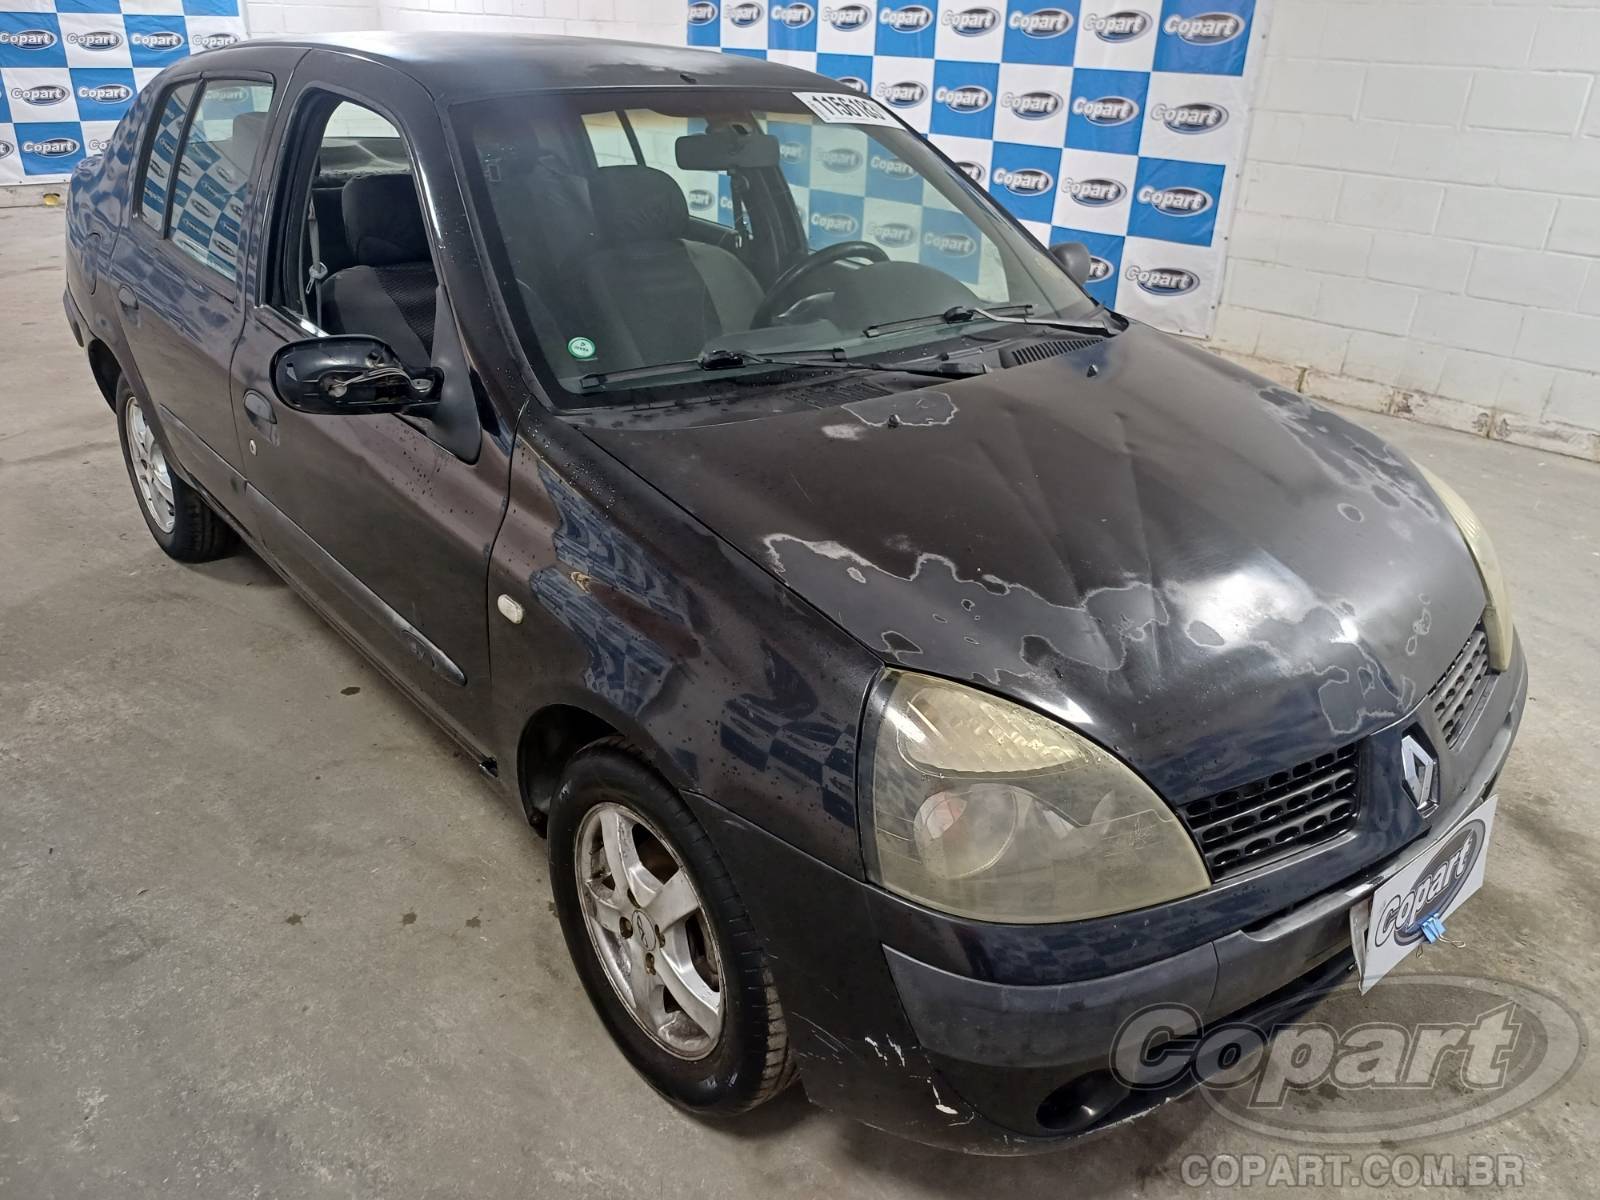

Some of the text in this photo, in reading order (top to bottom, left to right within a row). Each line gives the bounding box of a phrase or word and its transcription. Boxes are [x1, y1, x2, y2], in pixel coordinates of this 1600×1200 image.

[688, 5, 713, 21] part
[771, 5, 809, 24] Copart
[822, 7, 867, 26] Copart
[879, 8, 927, 28] Copart
[941, 9, 993, 31] Copart
[1009, 10, 1064, 32] Copart
[1084, 13, 1143, 35] Copart
[1163, 14, 1235, 37] Copart
[0, 31, 51, 46] Copart
[66, 32, 118, 47] Copart
[130, 32, 179, 47] Copart
[192, 35, 235, 49] Copart
[11, 87, 63, 101] Copart
[78, 86, 128, 101] Copart
[876, 82, 923, 103] Copart
[935, 86, 987, 107] Copart
[1001, 92, 1057, 114] Copart
[1072, 96, 1132, 120] Copart
[1152, 103, 1219, 127] Copart
[22, 140, 74, 155] Copart
[993, 167, 1047, 191] Copart
[1061, 177, 1117, 201] Copart
[1137, 186, 1203, 210] Copart
[810, 212, 854, 234] Copart
[1125, 265, 1192, 291] Copart
[1375, 830, 1474, 947] Copart
